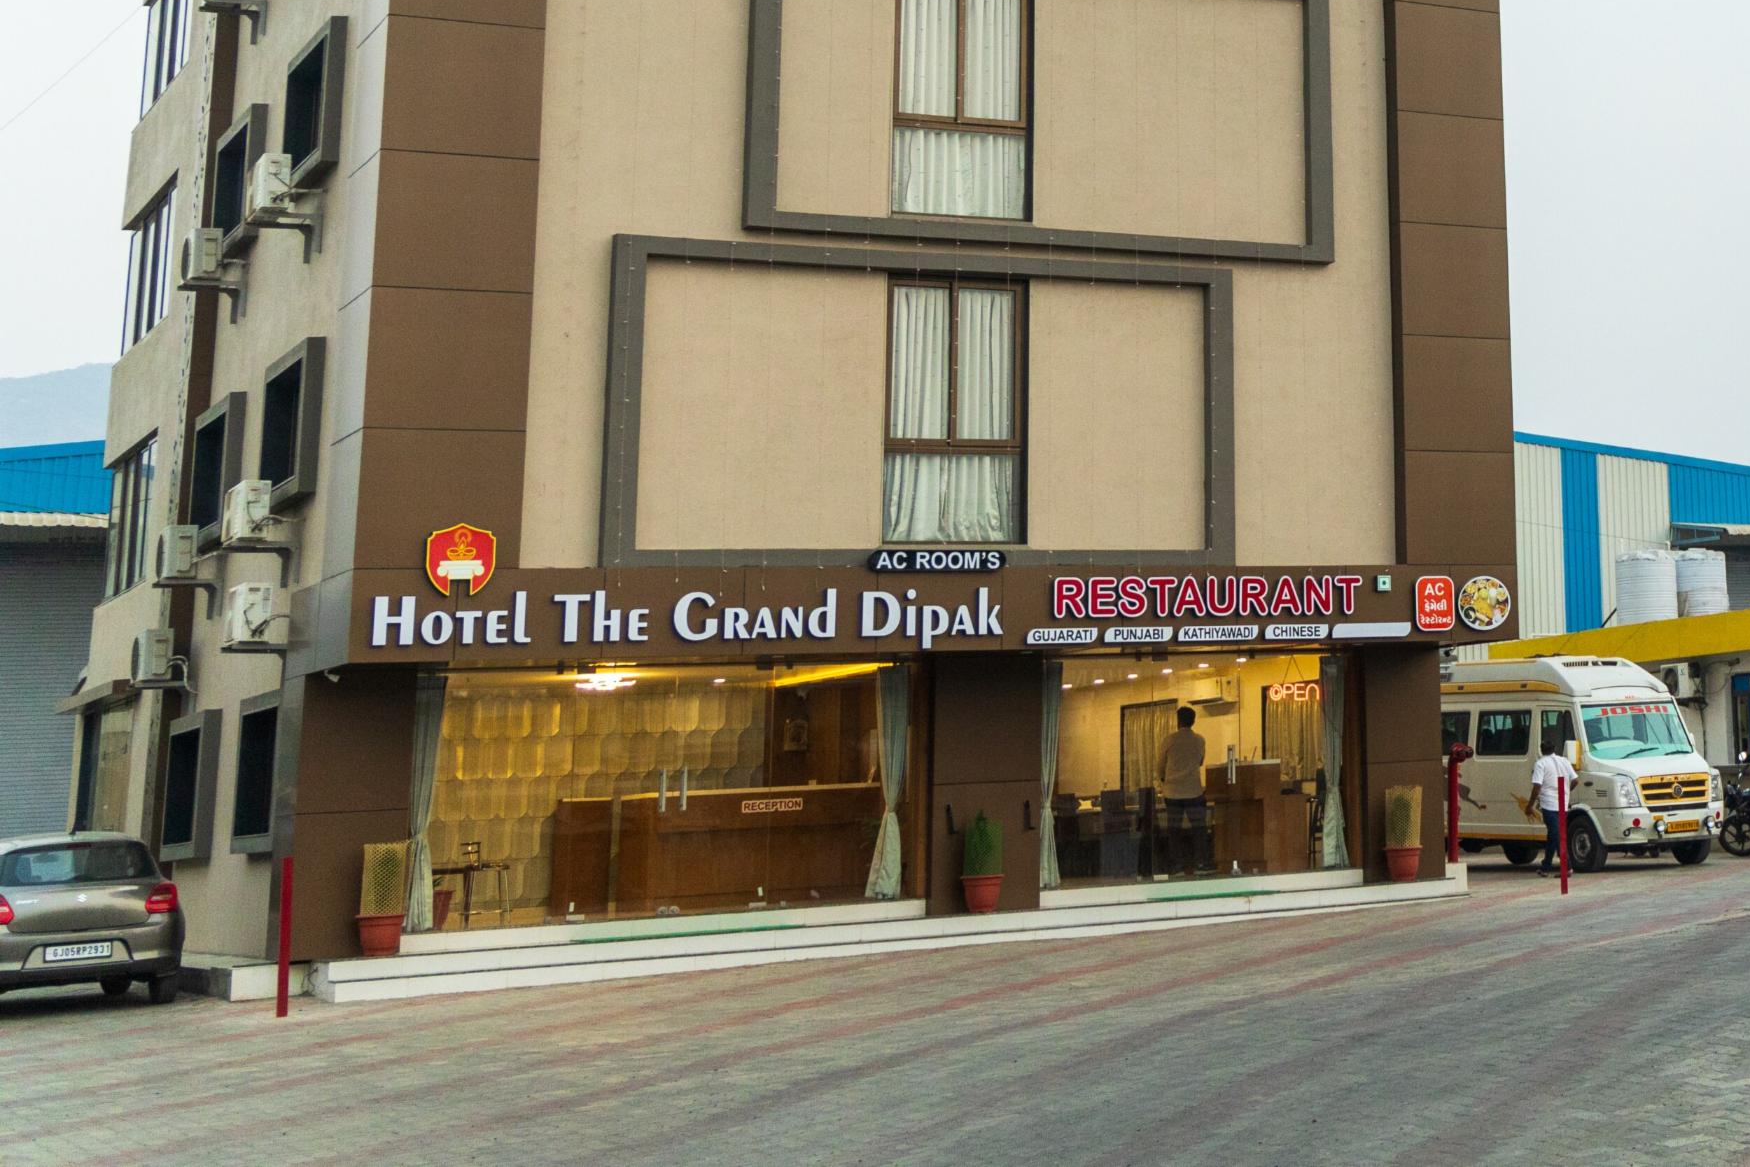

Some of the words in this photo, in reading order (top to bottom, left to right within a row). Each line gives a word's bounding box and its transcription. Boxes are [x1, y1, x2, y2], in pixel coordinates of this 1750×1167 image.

[876, 551, 907, 569] AC
[915, 551, 1000, 569] ROOM'S
[1053, 575, 1363, 619] RESTAURANT
[1424, 582, 1445, 596] AC
[1032, 629, 1095, 643] GUJARATI
[1113, 628, 1165, 641] PUNJABI
[1183, 626, 1255, 640] KATHIYAWADI
[1272, 625, 1321, 638] CHINESE
[1269, 683, 1321, 701] OPEN
[1596, 705, 1669, 716] JOSHI
[743, 798, 803, 812] RECEPTION
